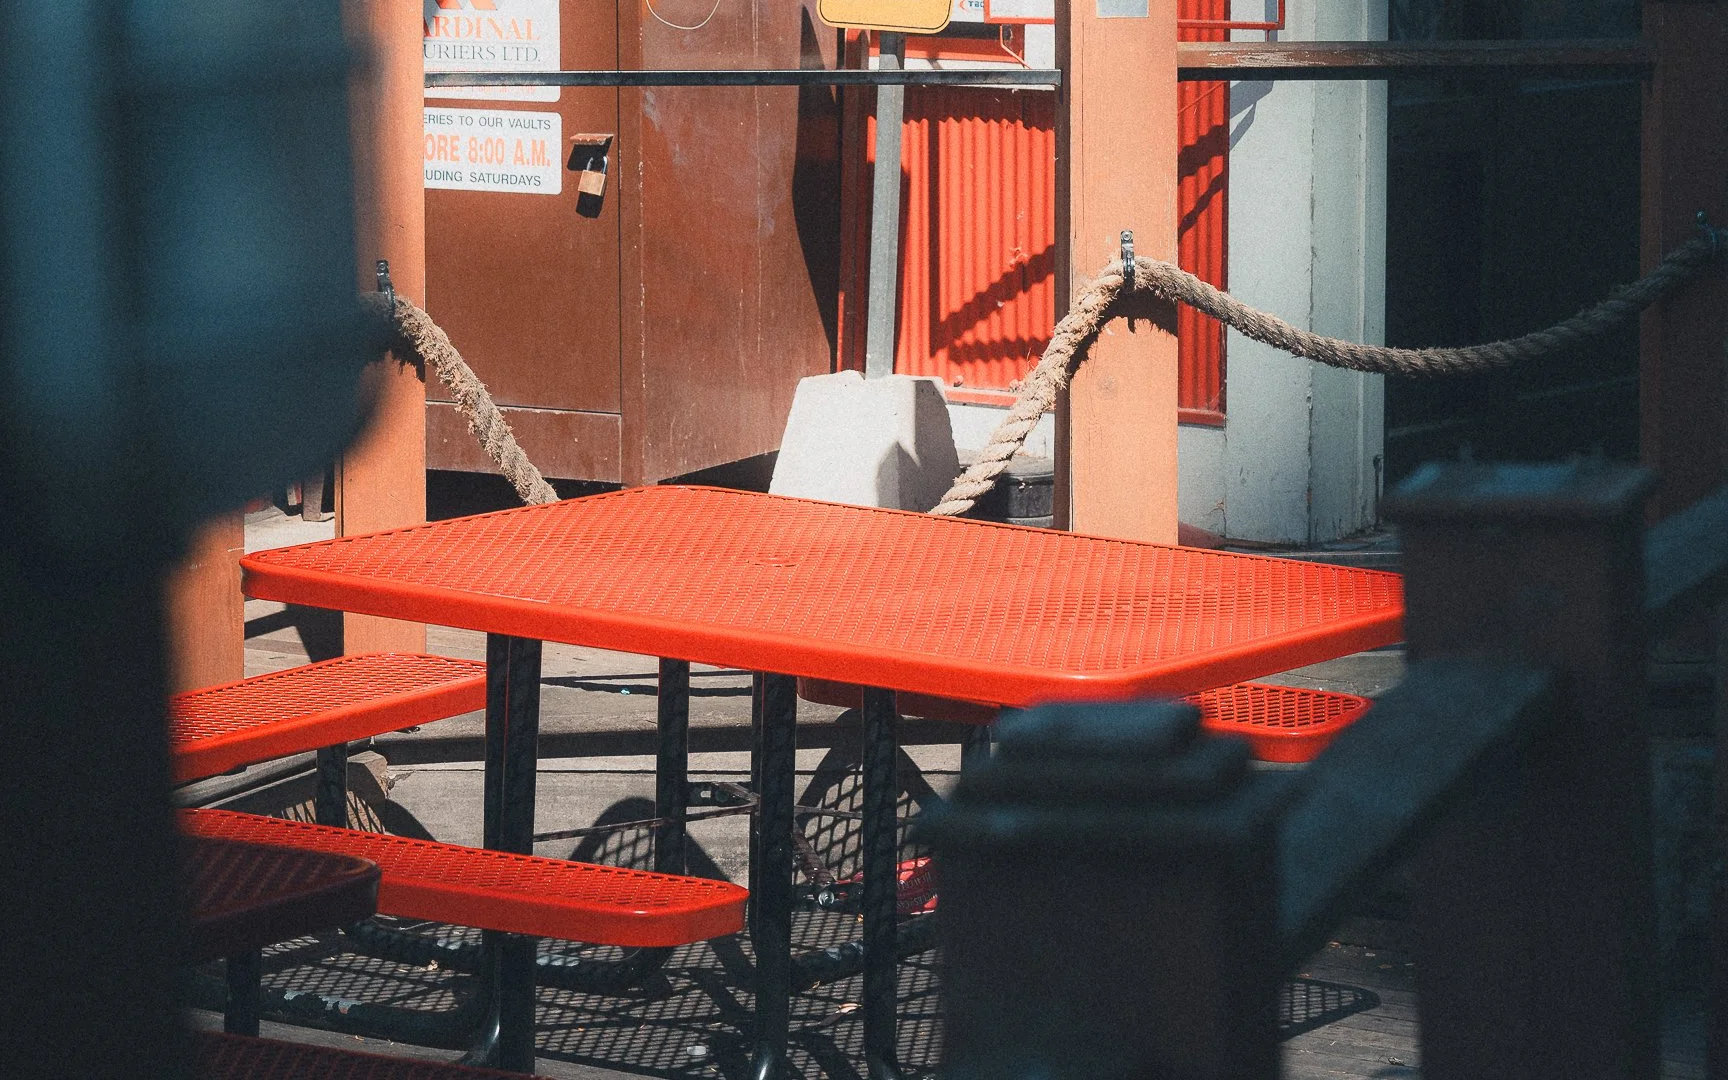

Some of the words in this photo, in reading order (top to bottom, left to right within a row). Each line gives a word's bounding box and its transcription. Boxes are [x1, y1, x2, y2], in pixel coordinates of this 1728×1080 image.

[424, 15, 541, 41] ARDINAL
[424, 44, 496, 60] URIERS
[503, 46, 541, 62] LTD.
[424, 113, 453, 125] ERIES
[458, 115, 473, 126] TO
[478, 116, 503, 128] OUR
[508, 118, 551, 130] VAULTS
[425, 132, 460, 162] ORE
[468, 135, 505, 165] 8:00
[513, 137, 551, 167] A.M.
[424, 169, 463, 182] UDING
[469, 171, 541, 187] SATURDAYS
